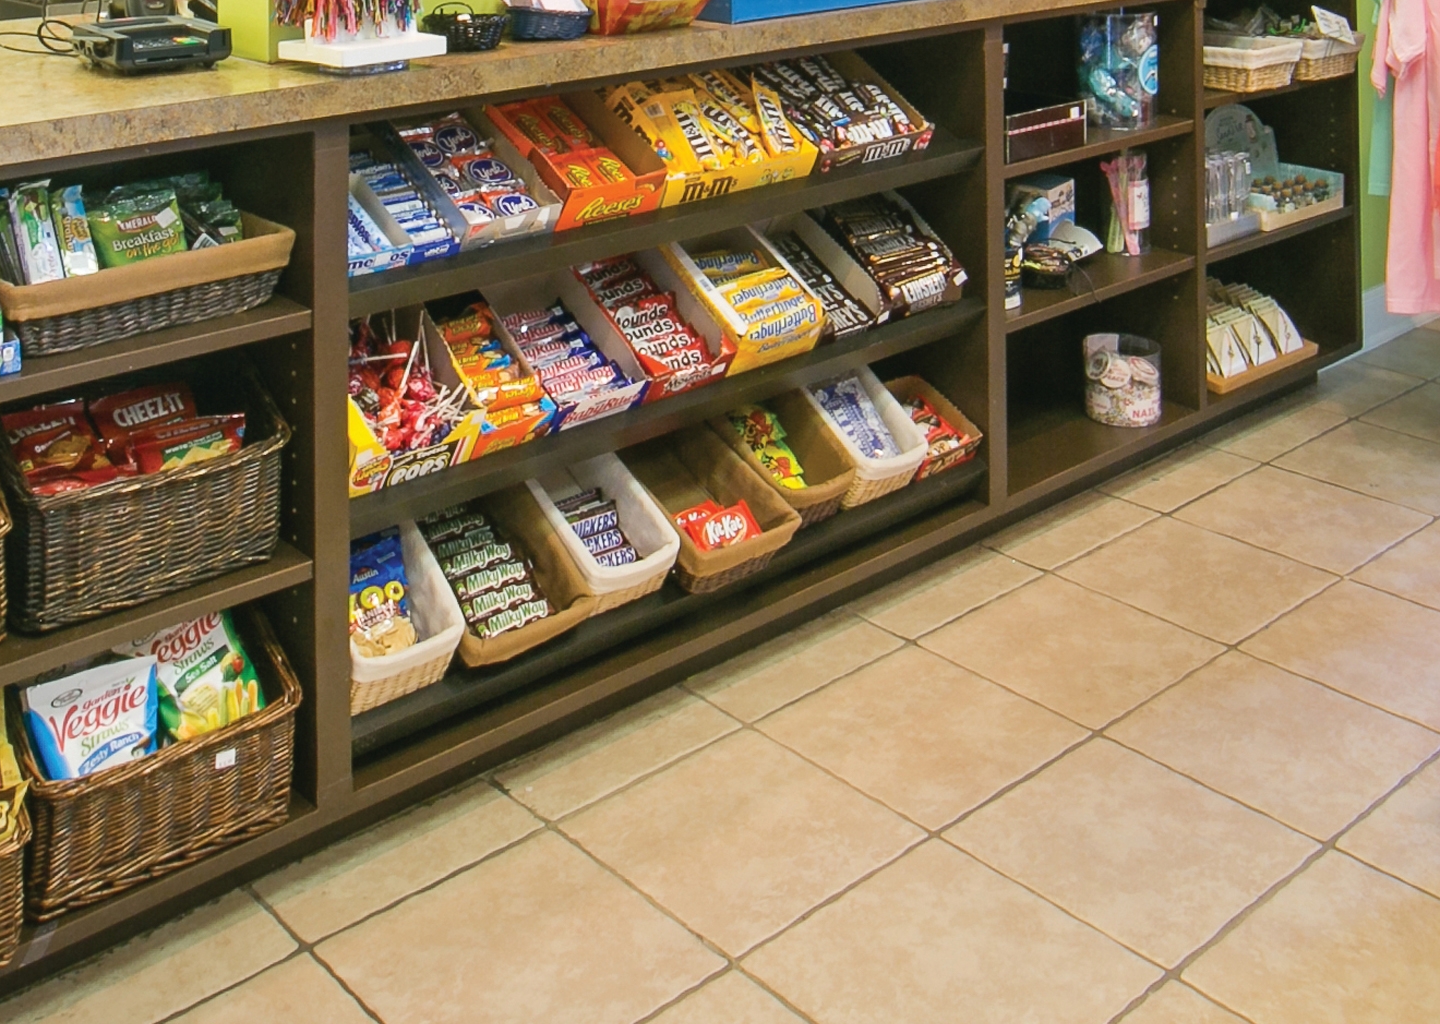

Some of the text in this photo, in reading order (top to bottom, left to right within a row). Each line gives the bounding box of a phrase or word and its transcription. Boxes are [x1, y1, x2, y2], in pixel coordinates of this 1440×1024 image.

[440, 127, 474, 149] York
[474, 162, 507, 181] York
[504, 197, 535, 217] York
[575, 193, 646, 222] Reese's
[112, 226, 175, 253] Breakfast
[126, 244, 142, 259] on
[348, 250, 410, 270] meos
[388, 454, 450, 487] POPS
[574, 511, 618, 536] NICKERS
[353, 568, 380, 585] Austin
[173, 638, 215, 676] Straws
[185, 655, 219, 683] Sea Salt
[49, 684, 148, 753] Veggie
[80, 717, 131, 758] Straws
[82, 732, 140, 774] Zesty Ranch
